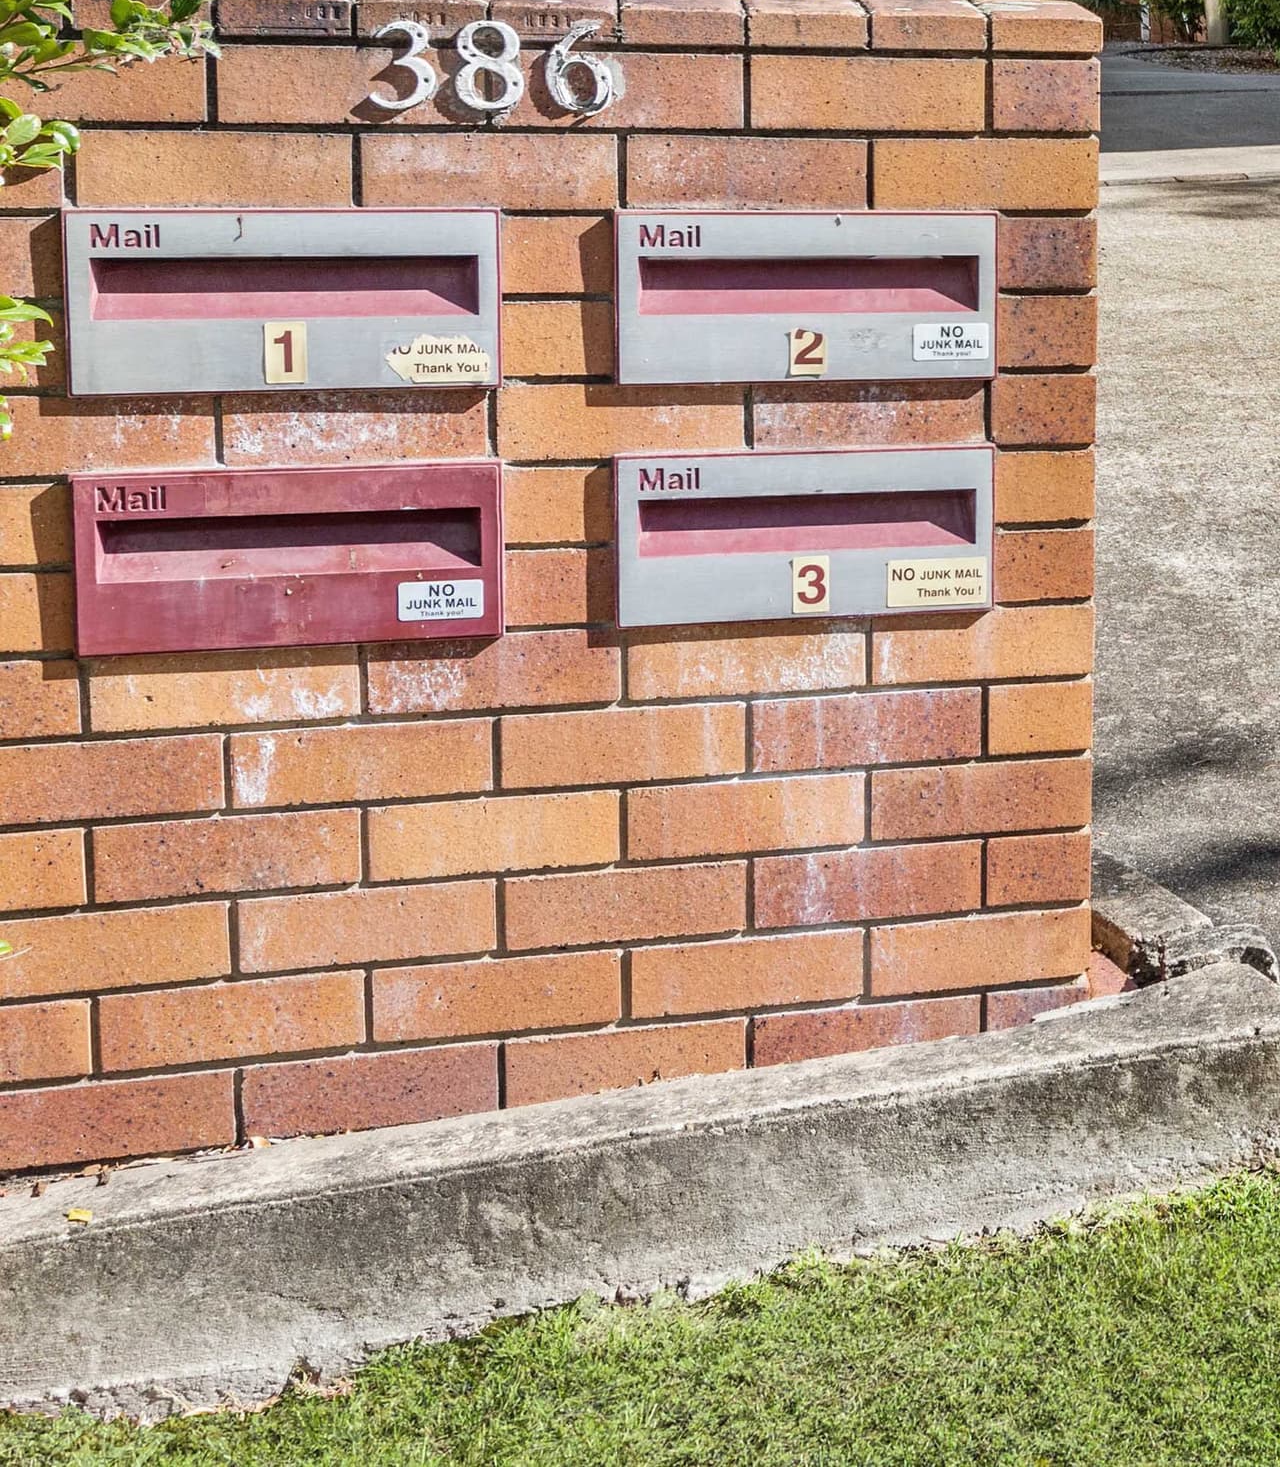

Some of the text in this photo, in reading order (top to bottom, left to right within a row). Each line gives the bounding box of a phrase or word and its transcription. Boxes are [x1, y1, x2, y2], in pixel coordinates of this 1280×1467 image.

[369, 19, 613, 118] 386
[89, 223, 161, 249] Mail
[638, 224, 702, 249] Mail
[939, 326, 964, 338] NO
[273, 330, 294, 373] 1
[416, 344, 453, 355] JUNK
[793, 328, 824, 366] 2
[920, 340, 983, 350] JUNK MAIL
[413, 362, 453, 374] Thank
[456, 362, 480, 374] You
[638, 467, 701, 492] Mail
[94, 484, 168, 514] Mail
[891, 568, 983, 582] NO JUNK MAIL
[428, 583, 456, 597] NO
[796, 564, 827, 605] 3
[916, 586, 951, 599] Thank
[954, 585, 975, 597] You
[405, 597, 478, 610] JUNK MAIL
[420, 610, 444, 618] Thank
